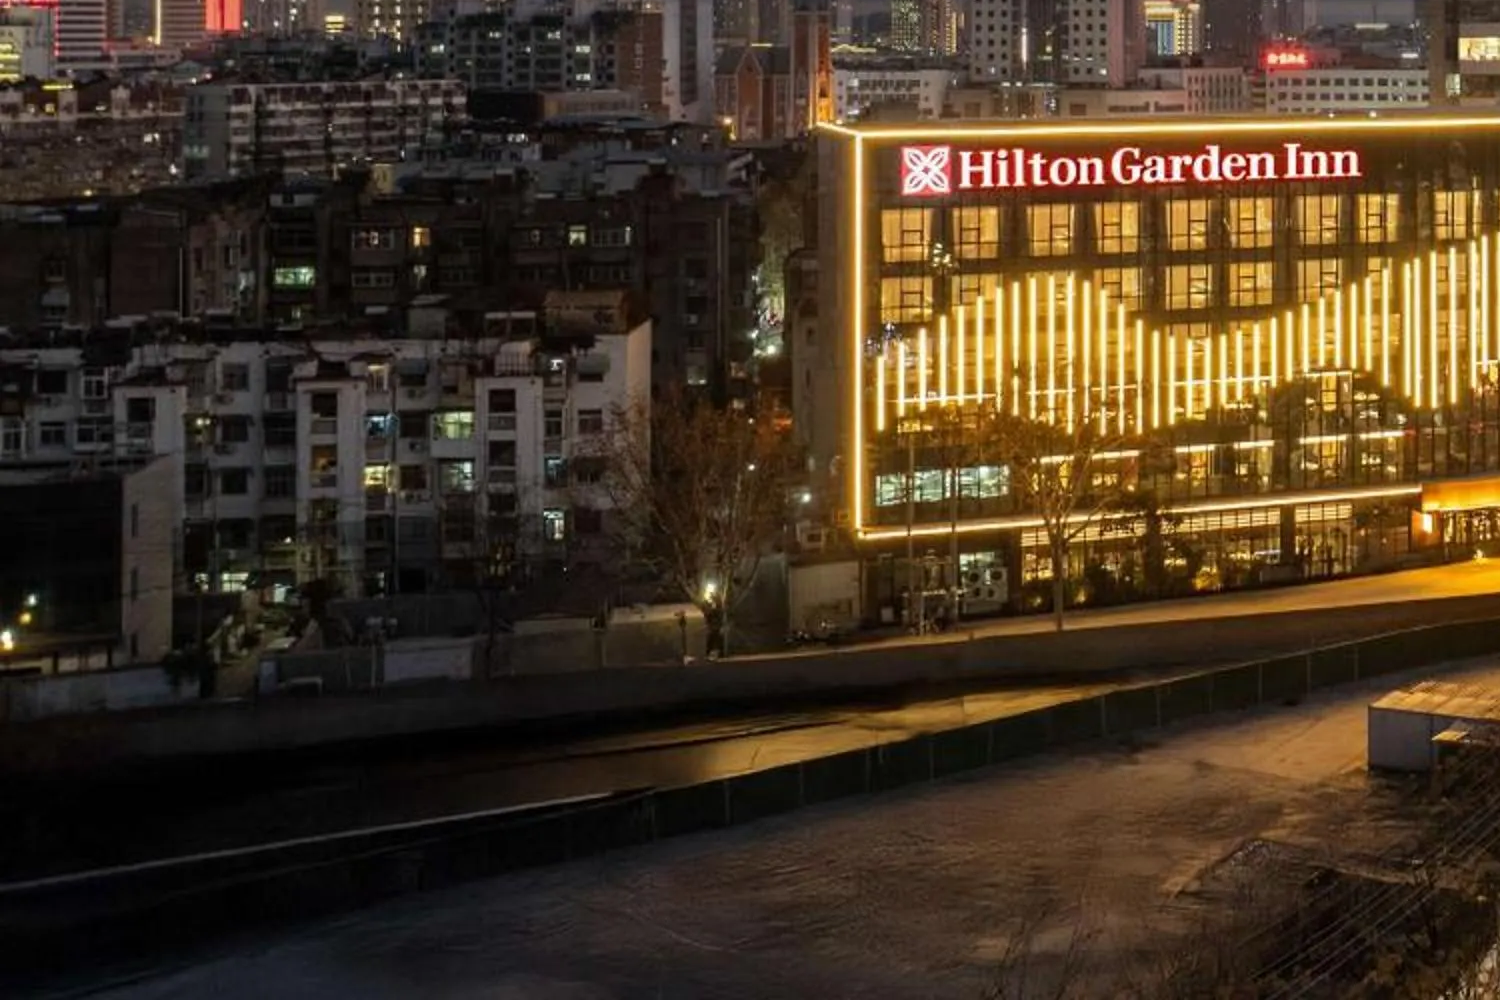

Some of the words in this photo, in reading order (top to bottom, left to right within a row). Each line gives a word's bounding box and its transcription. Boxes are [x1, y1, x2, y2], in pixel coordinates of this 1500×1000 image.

[959, 148, 1105, 188] Hilton
[1111, 145, 1277, 184] Garden
[1283, 143, 1361, 178] Inn
